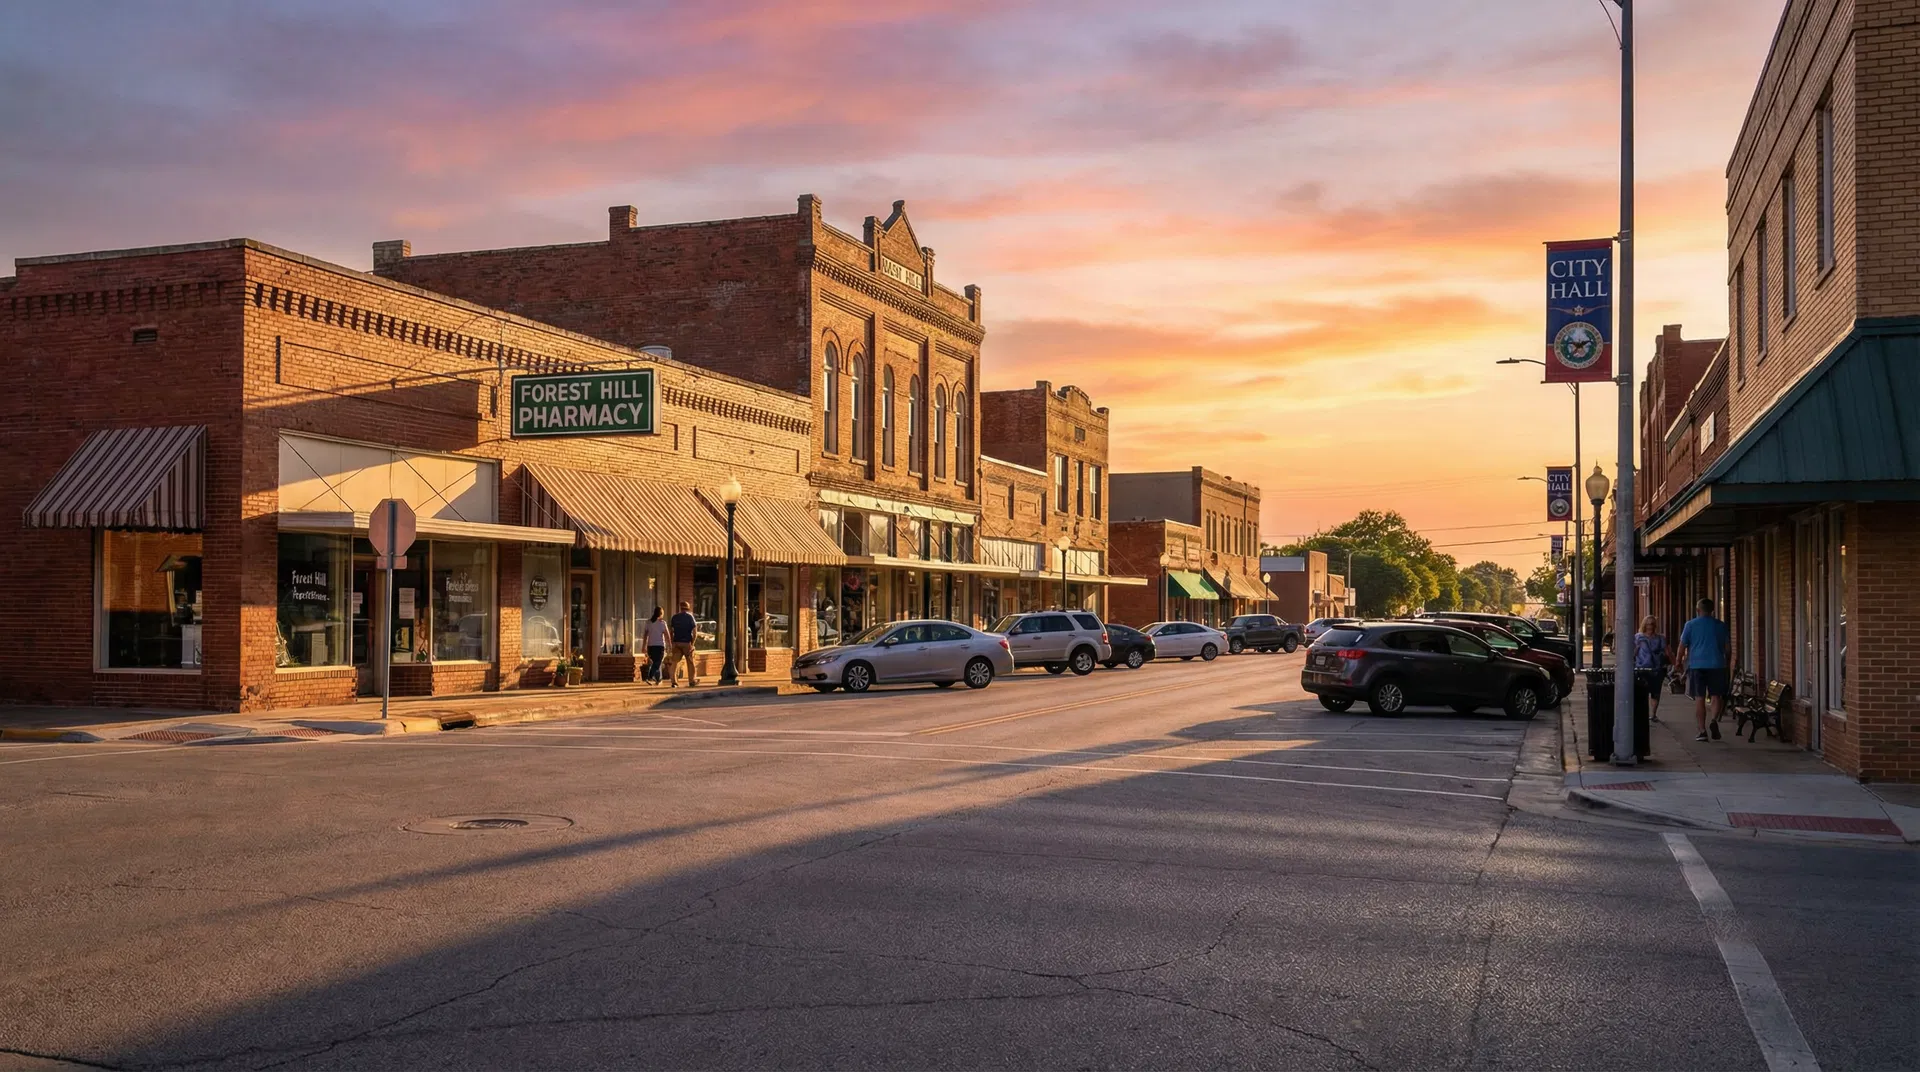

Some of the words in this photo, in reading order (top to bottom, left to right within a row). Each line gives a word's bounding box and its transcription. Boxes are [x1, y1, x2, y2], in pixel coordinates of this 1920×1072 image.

[1550, 258, 1607, 278] CITY
[1550, 280, 1608, 299] HALL
[521, 382, 592, 403] FOREST
[600, 380, 643, 400] HILL
[519, 402, 643, 429] PHARMACY
[1548, 473, 1570, 482] CITY
[1548, 482, 1571, 491] HALL
